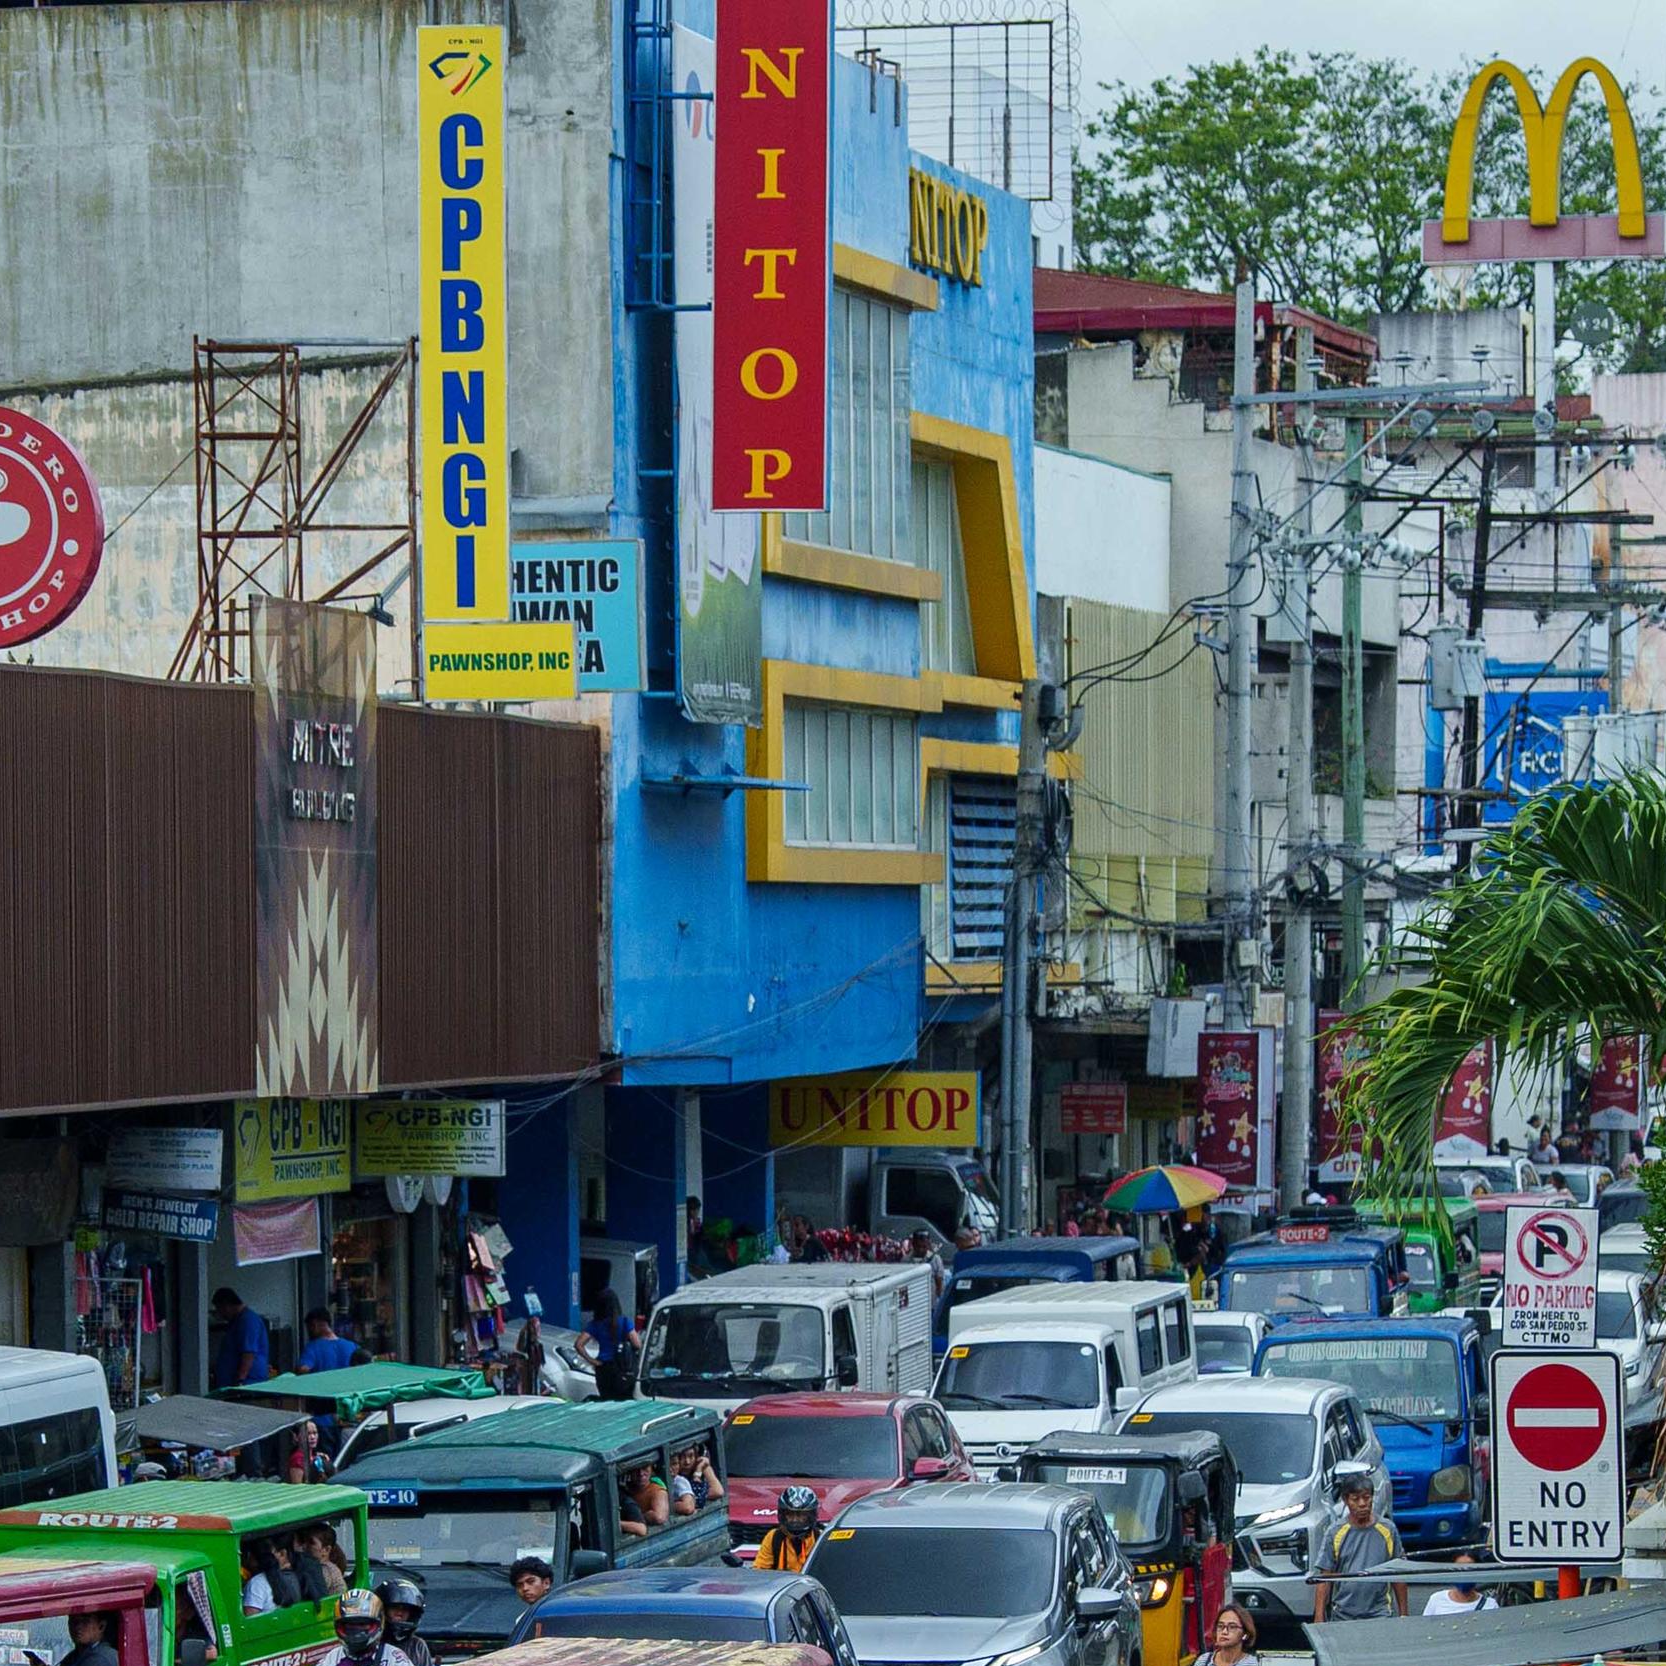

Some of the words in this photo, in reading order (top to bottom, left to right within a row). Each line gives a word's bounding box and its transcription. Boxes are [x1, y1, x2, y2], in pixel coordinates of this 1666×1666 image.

[511, 557, 620, 594] HENTIC
[429, 651, 534, 673] PAWNSHOP,
[539, 651, 571, 671] INC
[779, 1087, 970, 1132] UNITOP
[154, 1196, 200, 1215] JEWELRY
[105, 1207, 136, 1228] GOLD
[137, 1210, 179, 1234] REPAIR
[180, 1215, 213, 1237] SHOP
[1505, 1284, 1530, 1308] NO
[1534, 1285, 1595, 1309] PARKING
[1514, 1310, 1539, 1320] FROM
[1541, 1311, 1565, 1321] HERE
[1568, 1312, 1580, 1321] TO
[1529, 1320, 1546, 1331] SAN
[1547, 1321, 1577, 1332] PEDRO
[1521, 1332, 1571, 1344] CTTMO
[1067, 1468, 1127, 1483] ROUTE-A-1
[1540, 1480, 1587, 1510] NO
[1508, 1521, 1611, 1549] ENTRY
